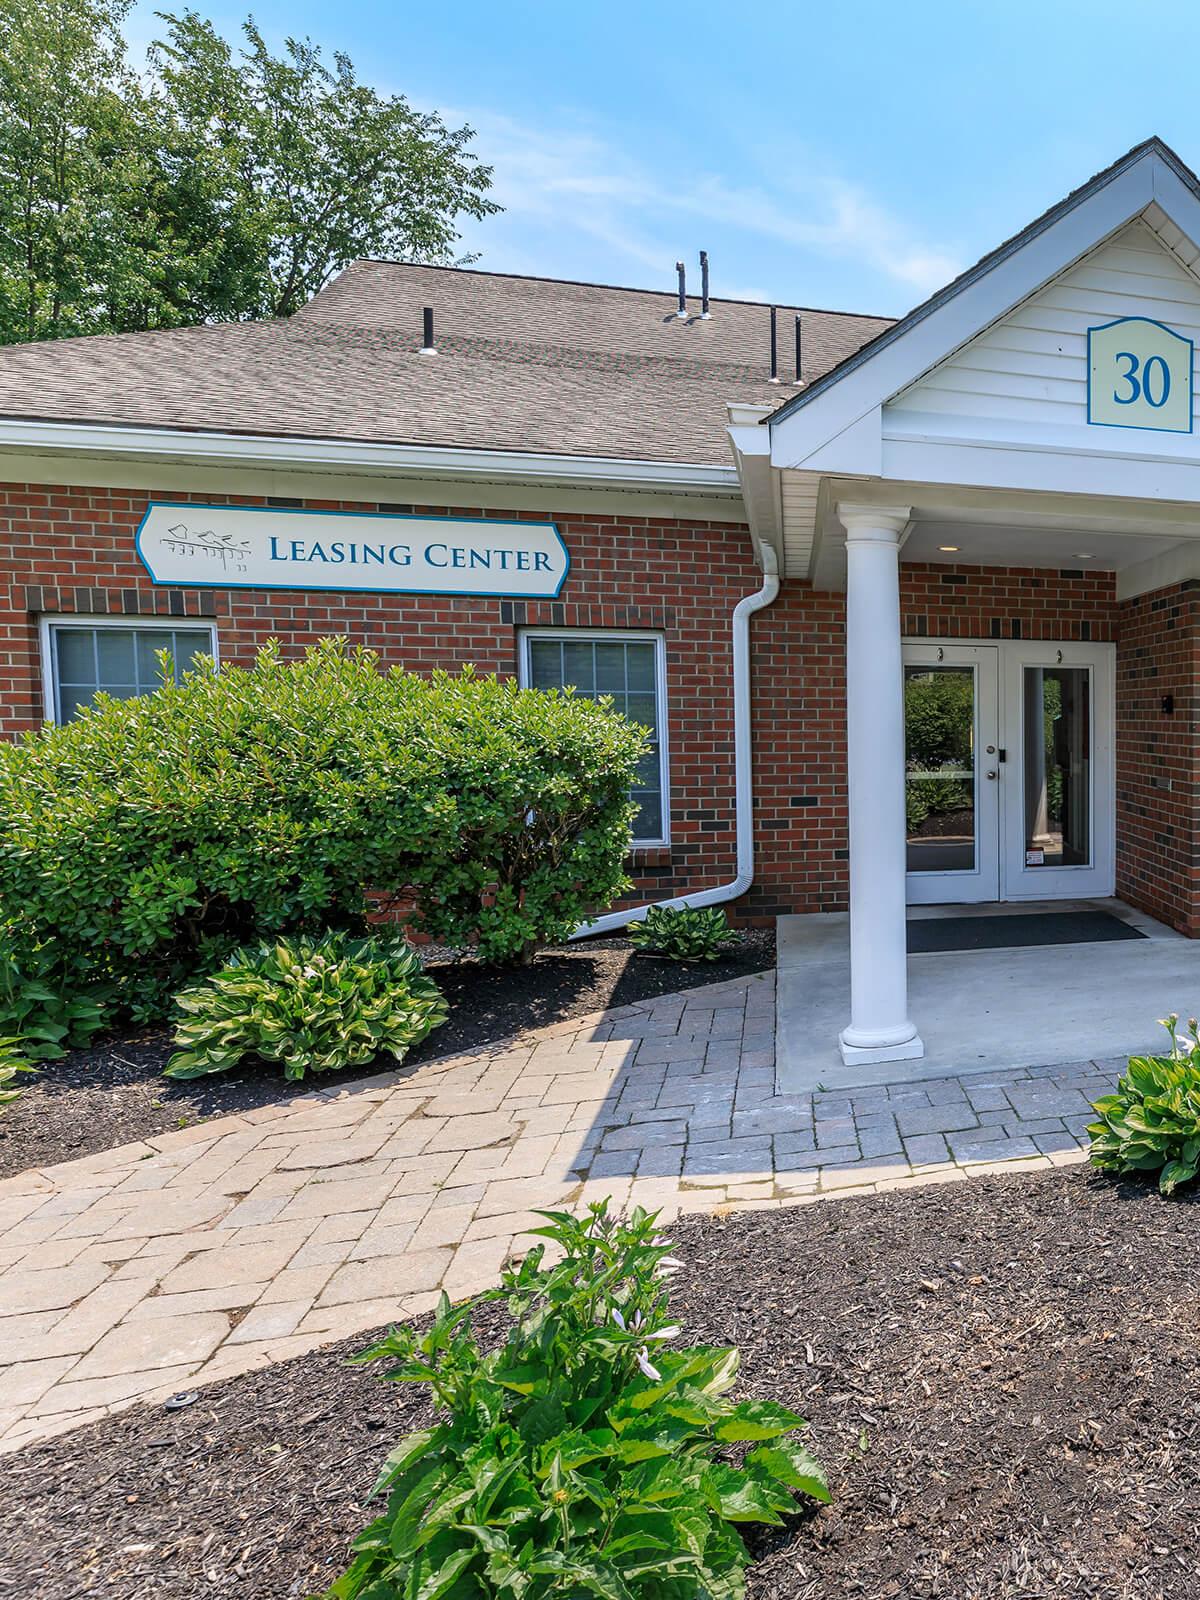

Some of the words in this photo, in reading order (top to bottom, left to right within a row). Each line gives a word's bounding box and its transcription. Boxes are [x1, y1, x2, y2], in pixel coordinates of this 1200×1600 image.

[1113, 352, 1171, 408] 30
[268, 536, 413, 566] LEASING
[424, 543, 555, 572] CENTER
